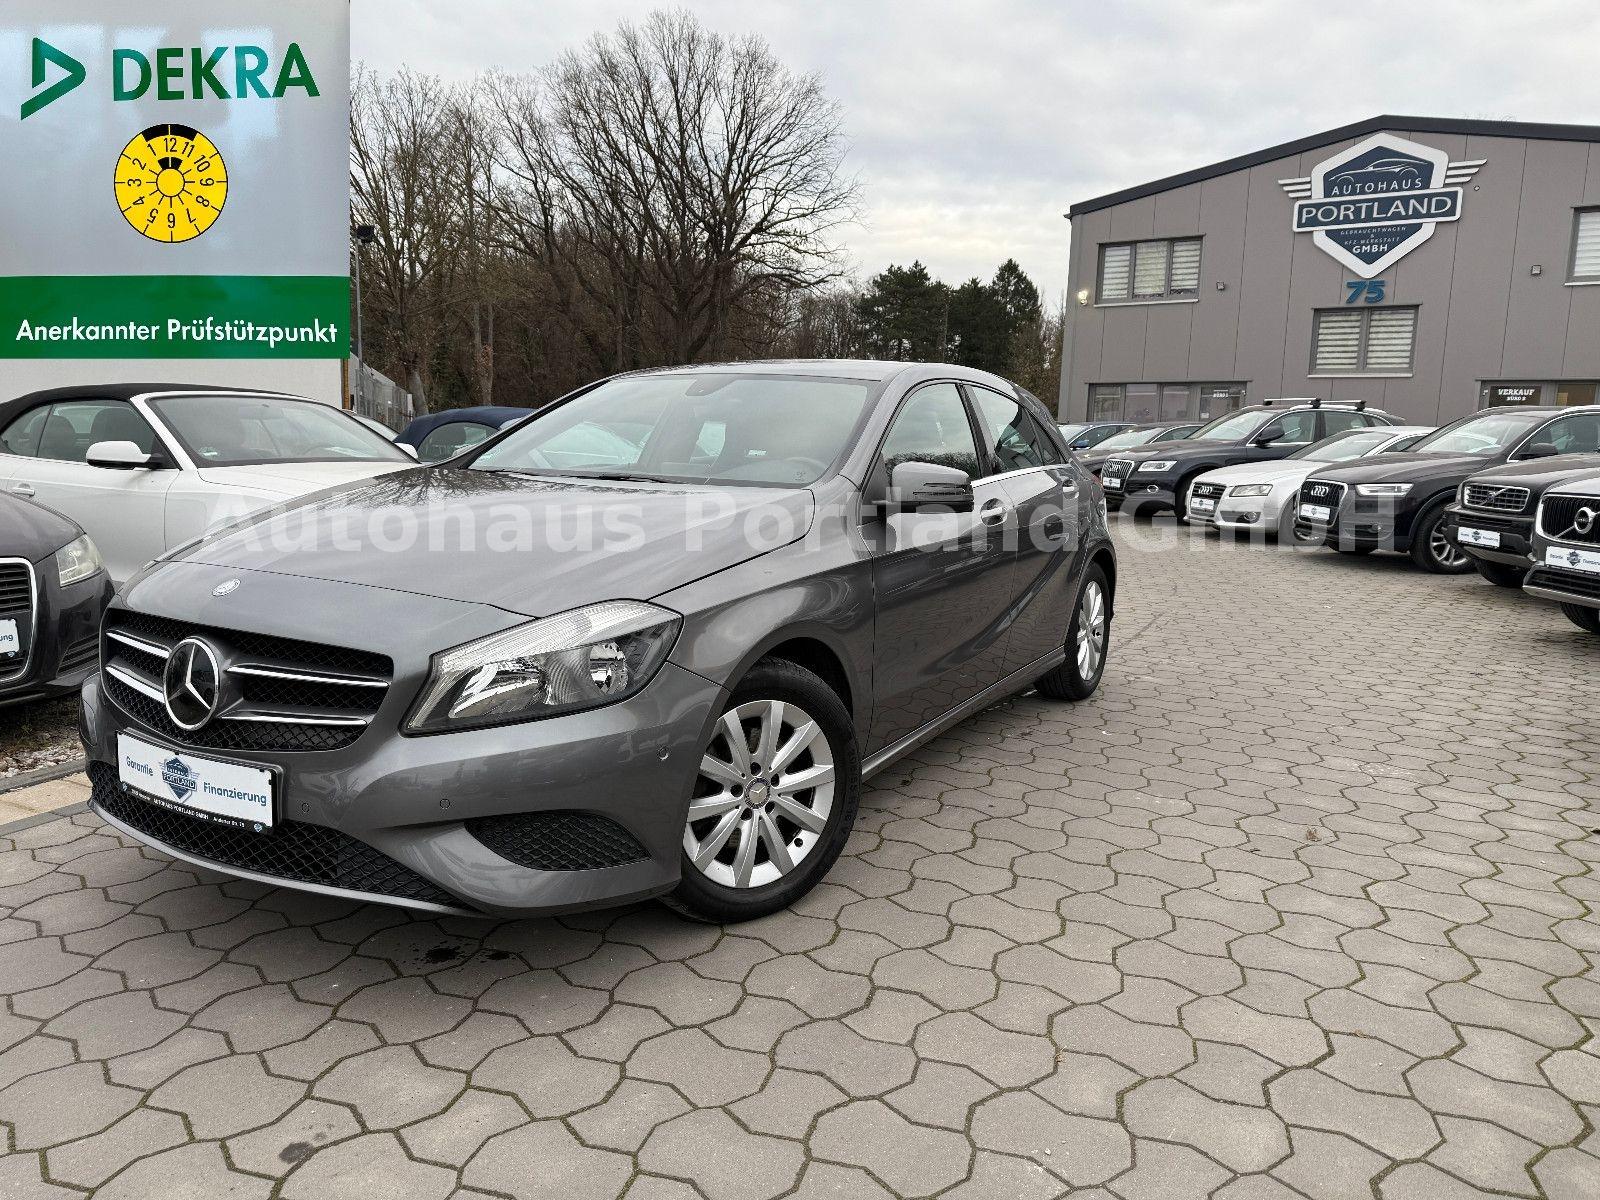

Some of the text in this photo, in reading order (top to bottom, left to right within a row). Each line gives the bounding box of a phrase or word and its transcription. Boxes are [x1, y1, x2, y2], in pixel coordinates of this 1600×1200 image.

[1331, 177, 1423, 196] AUTOHAUS
[1301, 196, 1452, 224] PORTLAND
[1352, 244, 1389, 254] GMBH
[1345, 279, 1386, 304] 75
[126, 755, 154, 777] Garantie
[203, 781, 267, 806] Finanzierung
